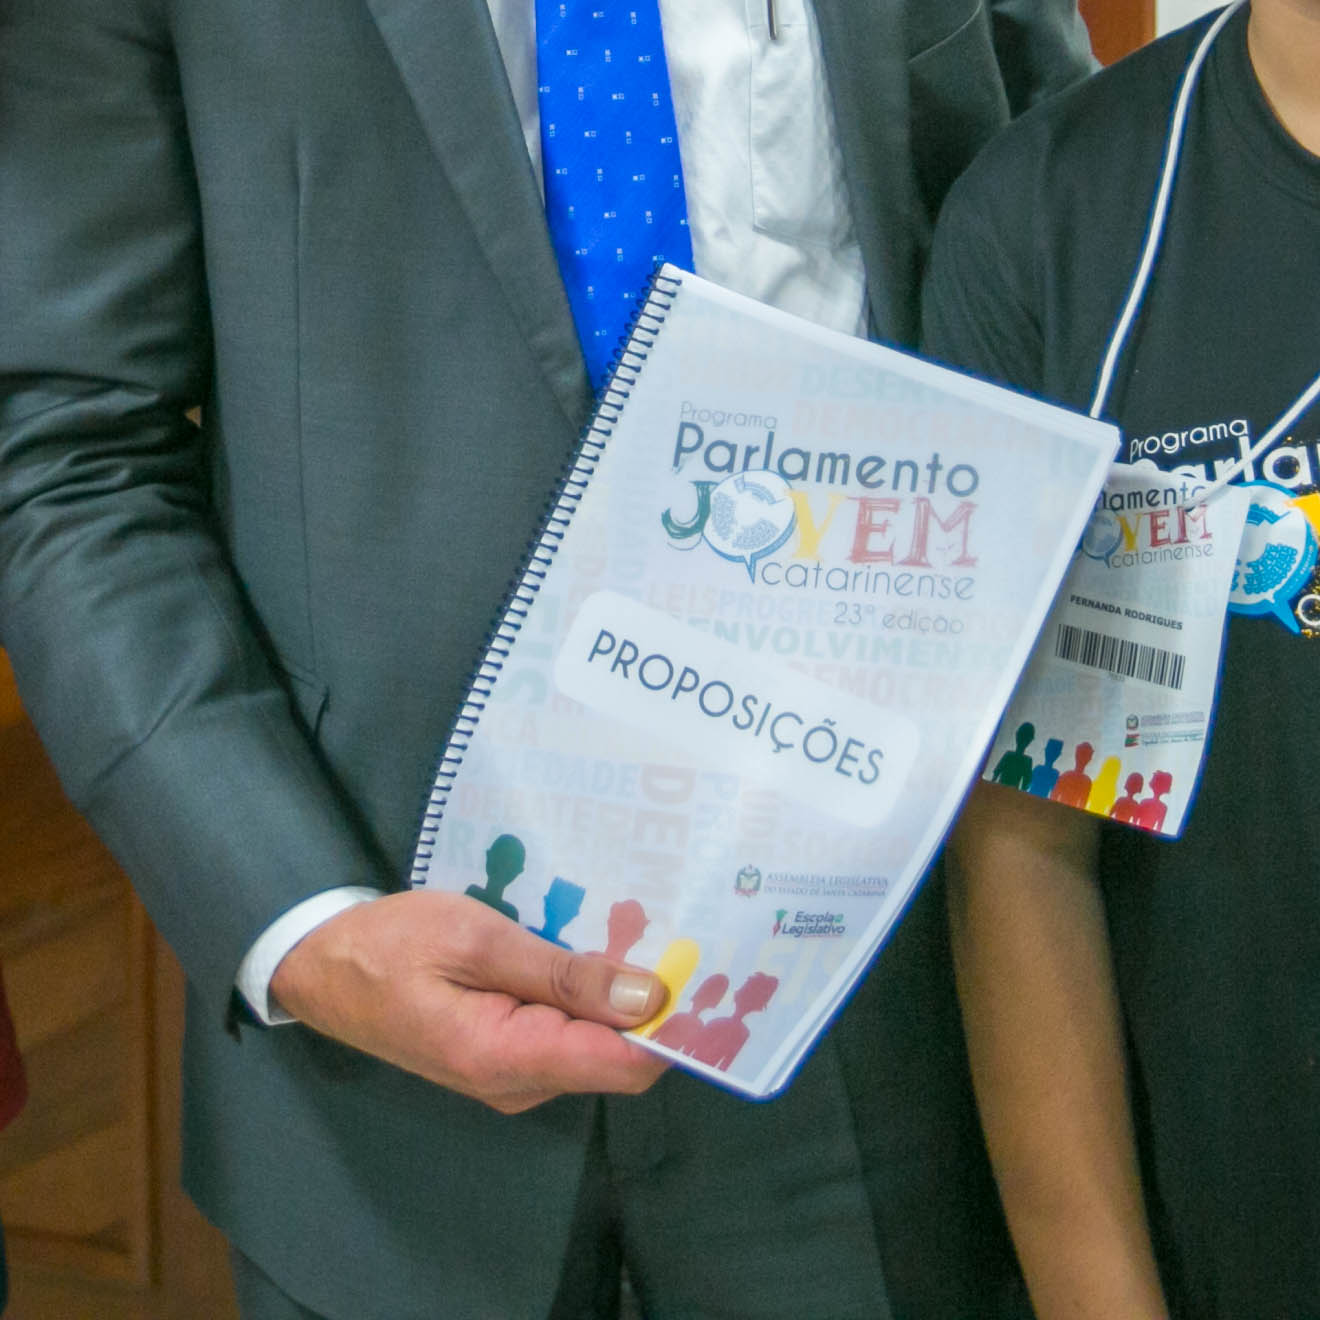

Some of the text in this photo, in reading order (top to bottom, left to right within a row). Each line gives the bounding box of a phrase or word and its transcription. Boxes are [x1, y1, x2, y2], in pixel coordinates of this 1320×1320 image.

[680, 400, 779, 431] Programa
[672, 420, 980, 498] Parlamento
[1130, 419, 1249, 463] Programa
[661, 470, 979, 572] JOVEM
[1110, 543, 1214, 568] catarinense
[760, 560, 976, 601] catarinense
[882, 609, 965, 636] edição
[1070, 594, 1183, 630] FERNANDA RODRIGUES
[587, 628, 885, 785] PROPOSIÇÕES
[782, 923, 846, 938] Legislativo
